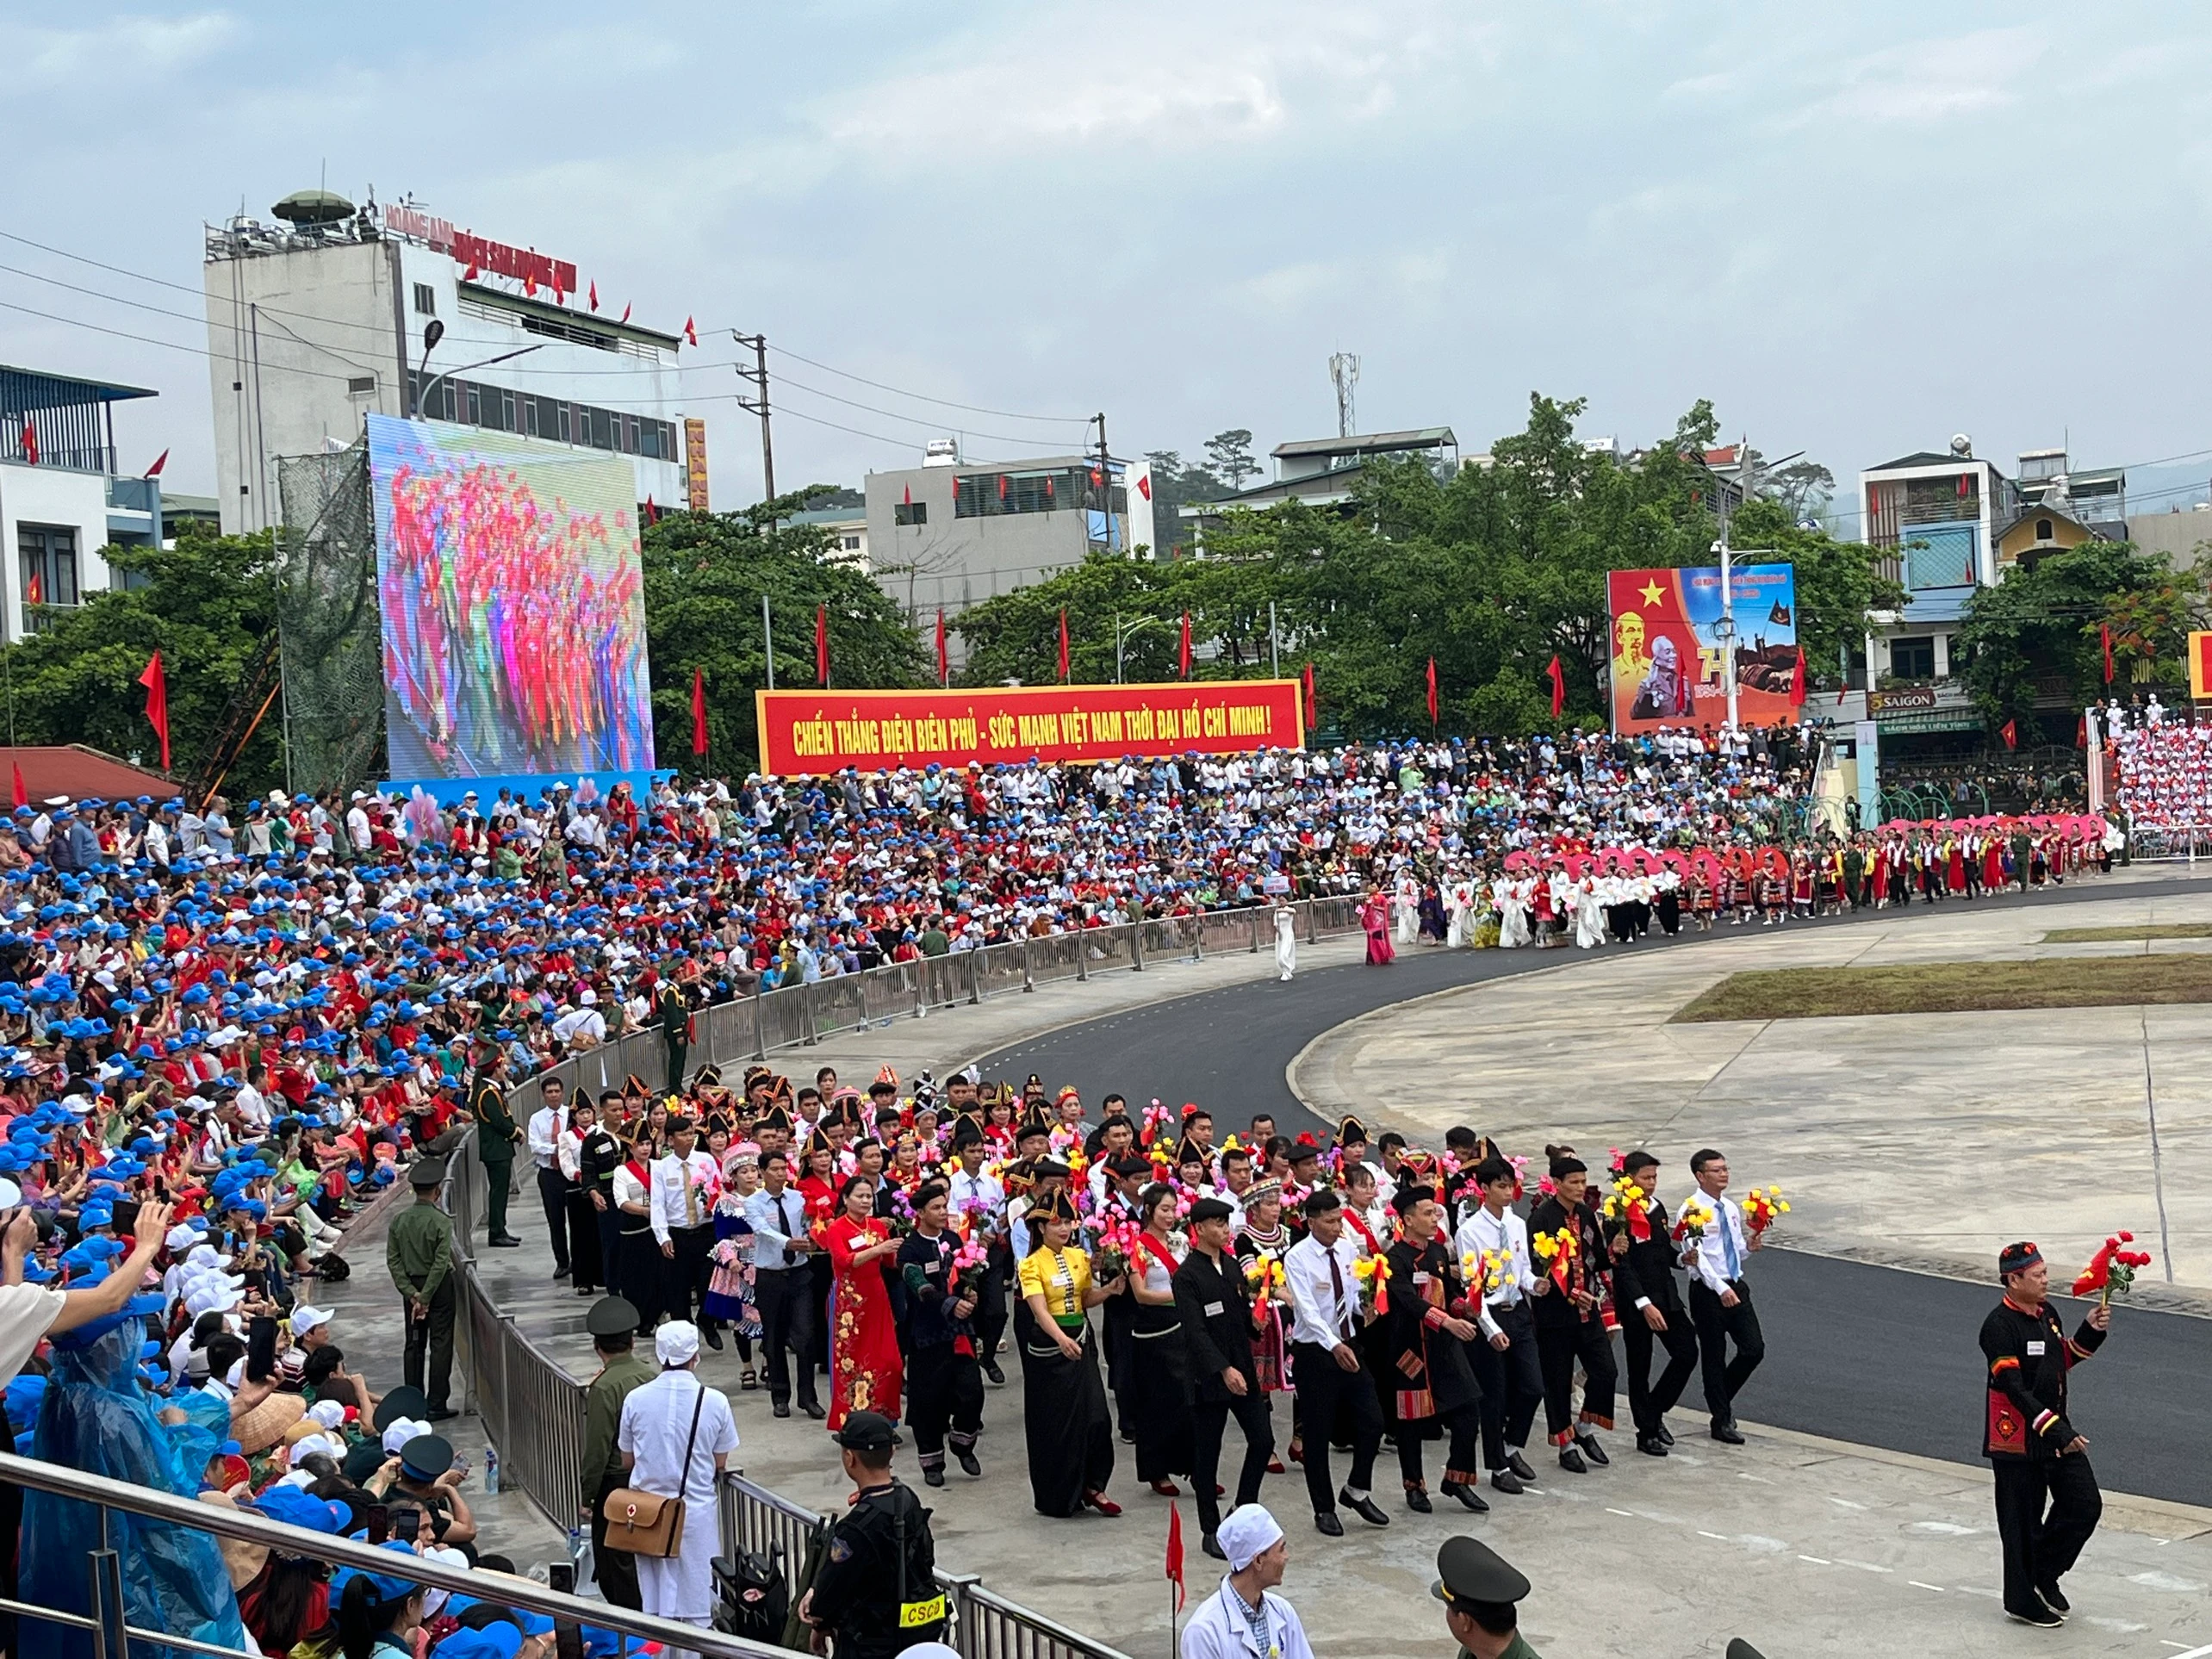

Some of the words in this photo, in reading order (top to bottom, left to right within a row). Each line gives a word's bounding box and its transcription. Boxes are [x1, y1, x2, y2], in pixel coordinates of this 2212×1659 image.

[1884, 695, 1930, 706] SAIGON
[792, 709, 835, 756] CHIẾN
[836, 707, 880, 755] THẮNG
[881, 712, 914, 761] ĐIỆN
[915, 711, 948, 753] BIÊN
[949, 706, 978, 751] PHỦ
[988, 709, 1016, 749] SỨC
[1017, 713, 1059, 754] MẠNH
[1059, 705, 1088, 751] VIỆT
[1090, 711, 1123, 743] NAM
[1123, 702, 1154, 741] THỜI
[1156, 709, 1180, 747] ĐẠI
[1182, 698, 1201, 739] HỒ
[1203, 700, 1227, 738] CHÍ
[908, 1601, 940, 1623] CSCĐ
